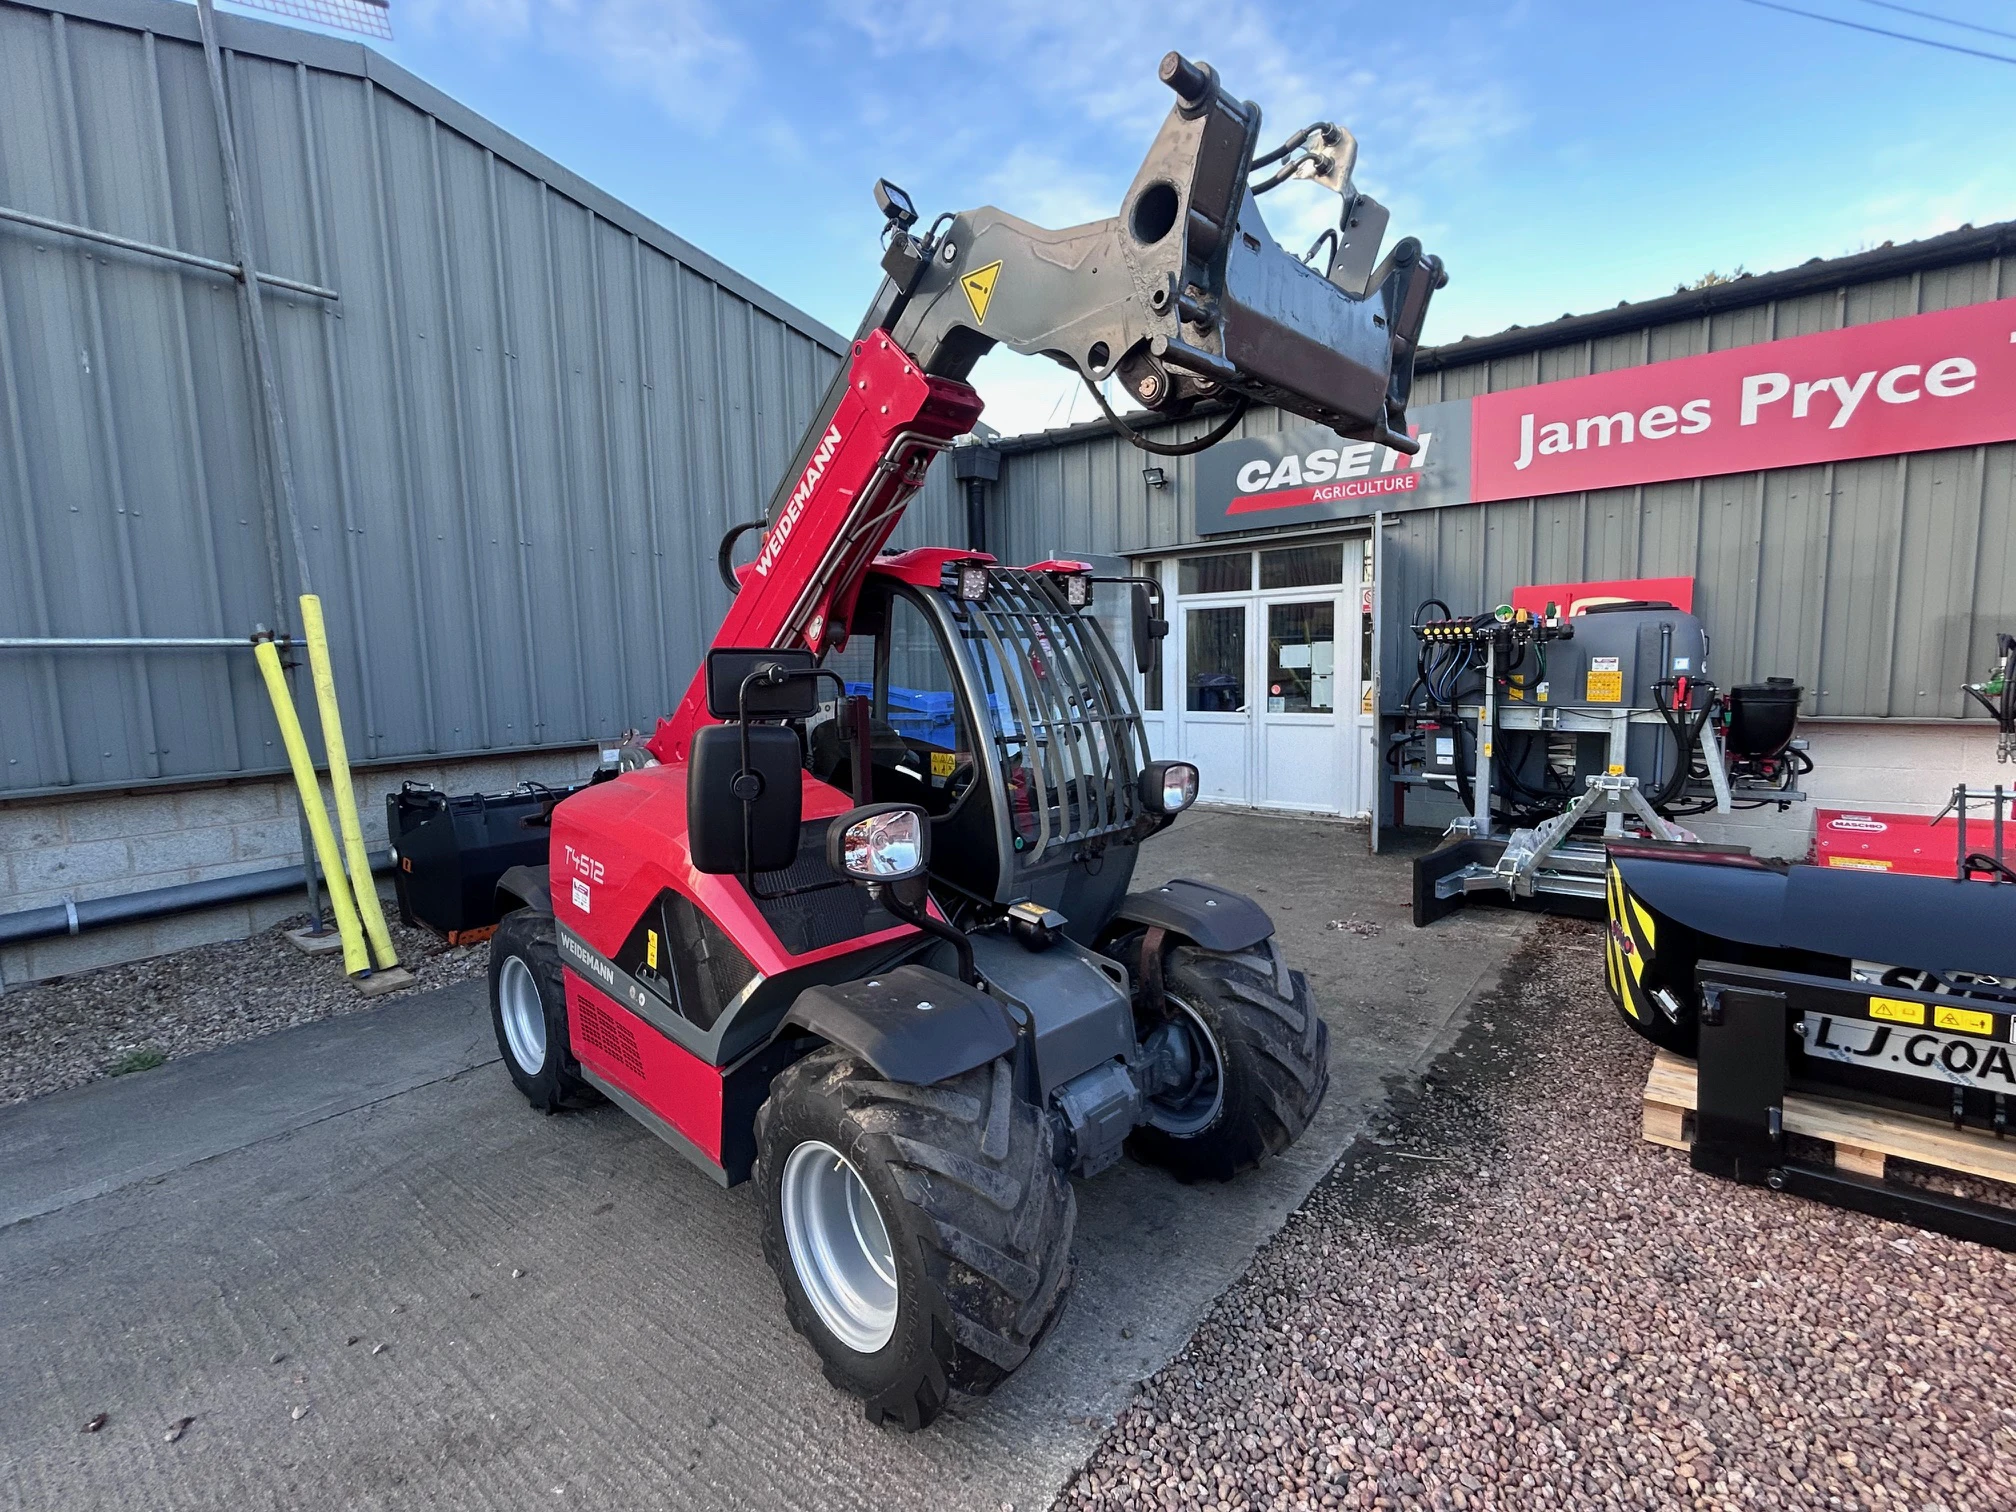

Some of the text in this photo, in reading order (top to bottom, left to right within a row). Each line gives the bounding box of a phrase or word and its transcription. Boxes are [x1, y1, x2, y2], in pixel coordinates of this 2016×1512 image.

[1513, 356, 1977, 470] James Pryce
[1236, 442, 1376, 493] CASE
[1312, 476, 1414, 501] AGRICULTURE
[755, 424, 842, 577] WEIDEMANN
[1834, 821, 1884, 829] MASCHIO
[564, 845, 605, 885] T4512
[561, 931, 614, 985] WEIDEMANN
